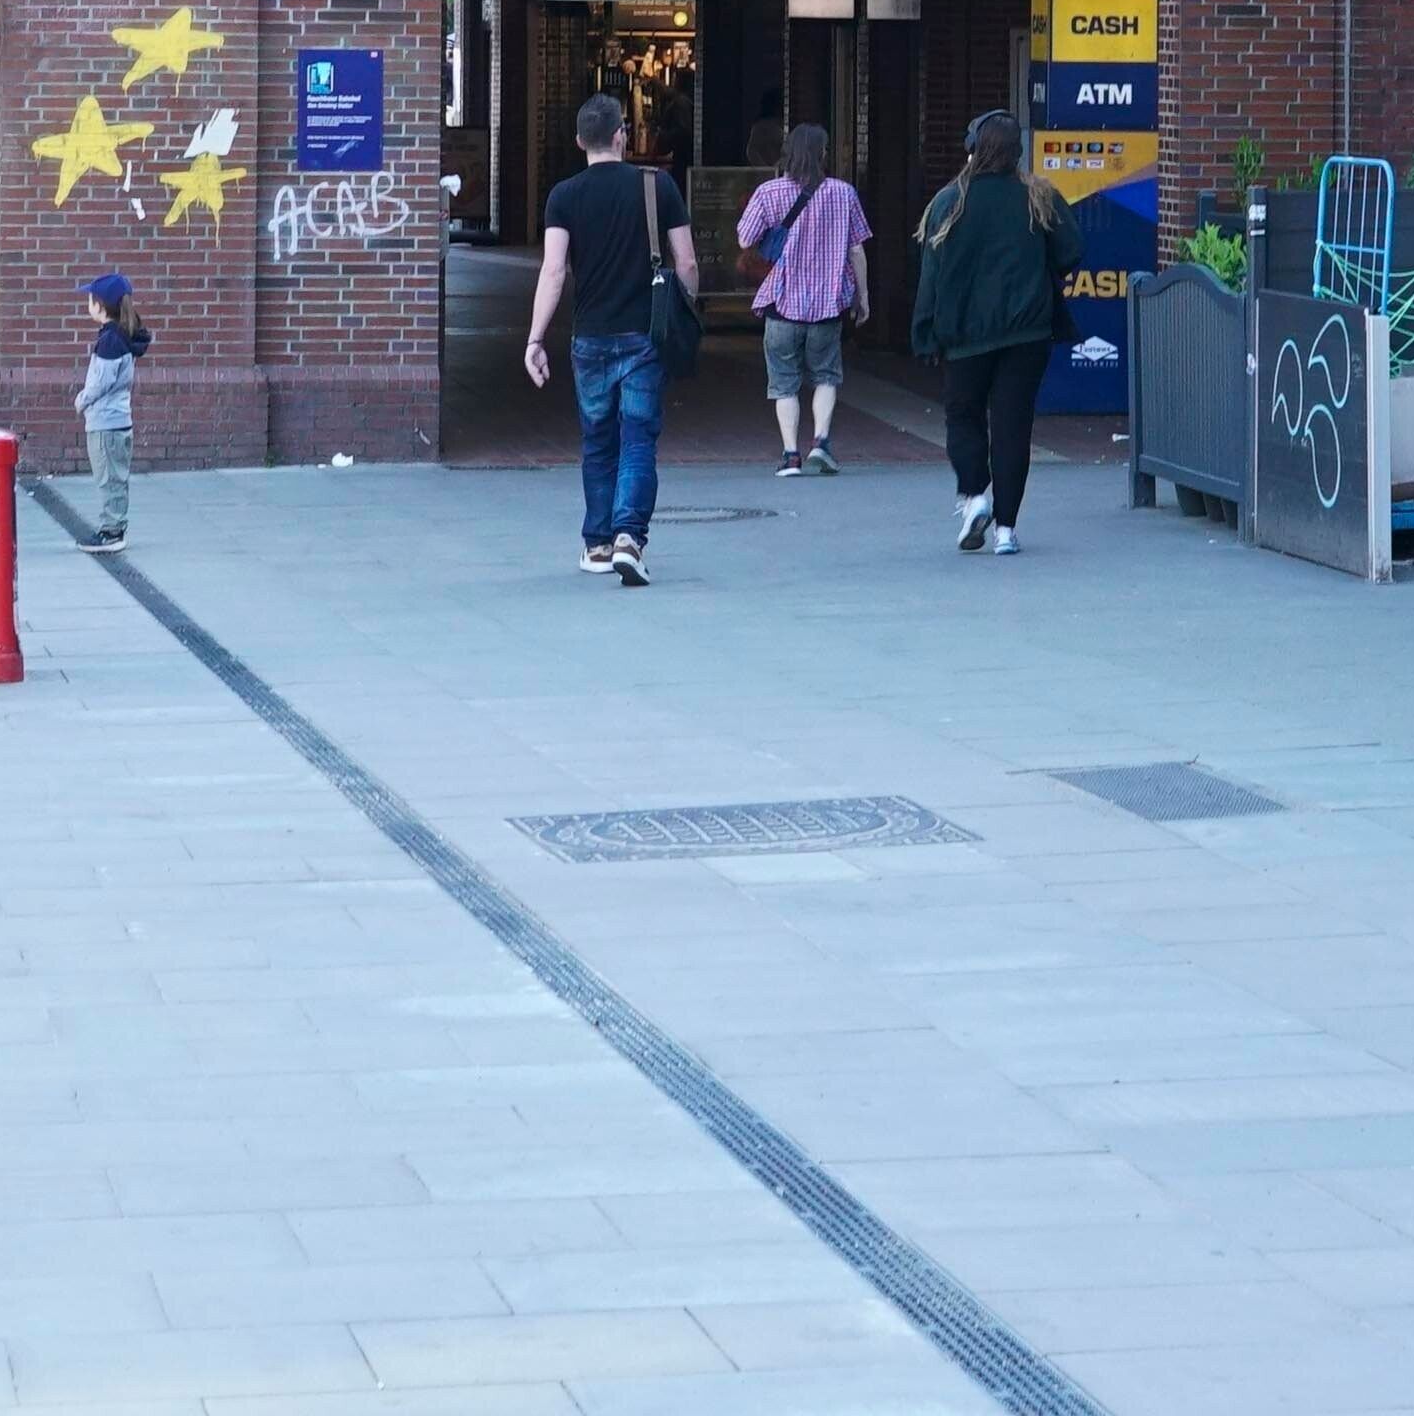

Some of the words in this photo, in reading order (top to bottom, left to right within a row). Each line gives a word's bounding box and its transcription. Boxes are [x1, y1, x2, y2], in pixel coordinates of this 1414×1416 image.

[1071, 15, 1139, 35] CASH
[1076, 83, 1132, 105] ATM
[268, 170, 409, 261] ACAB
[1063, 270, 1128, 298] AS
